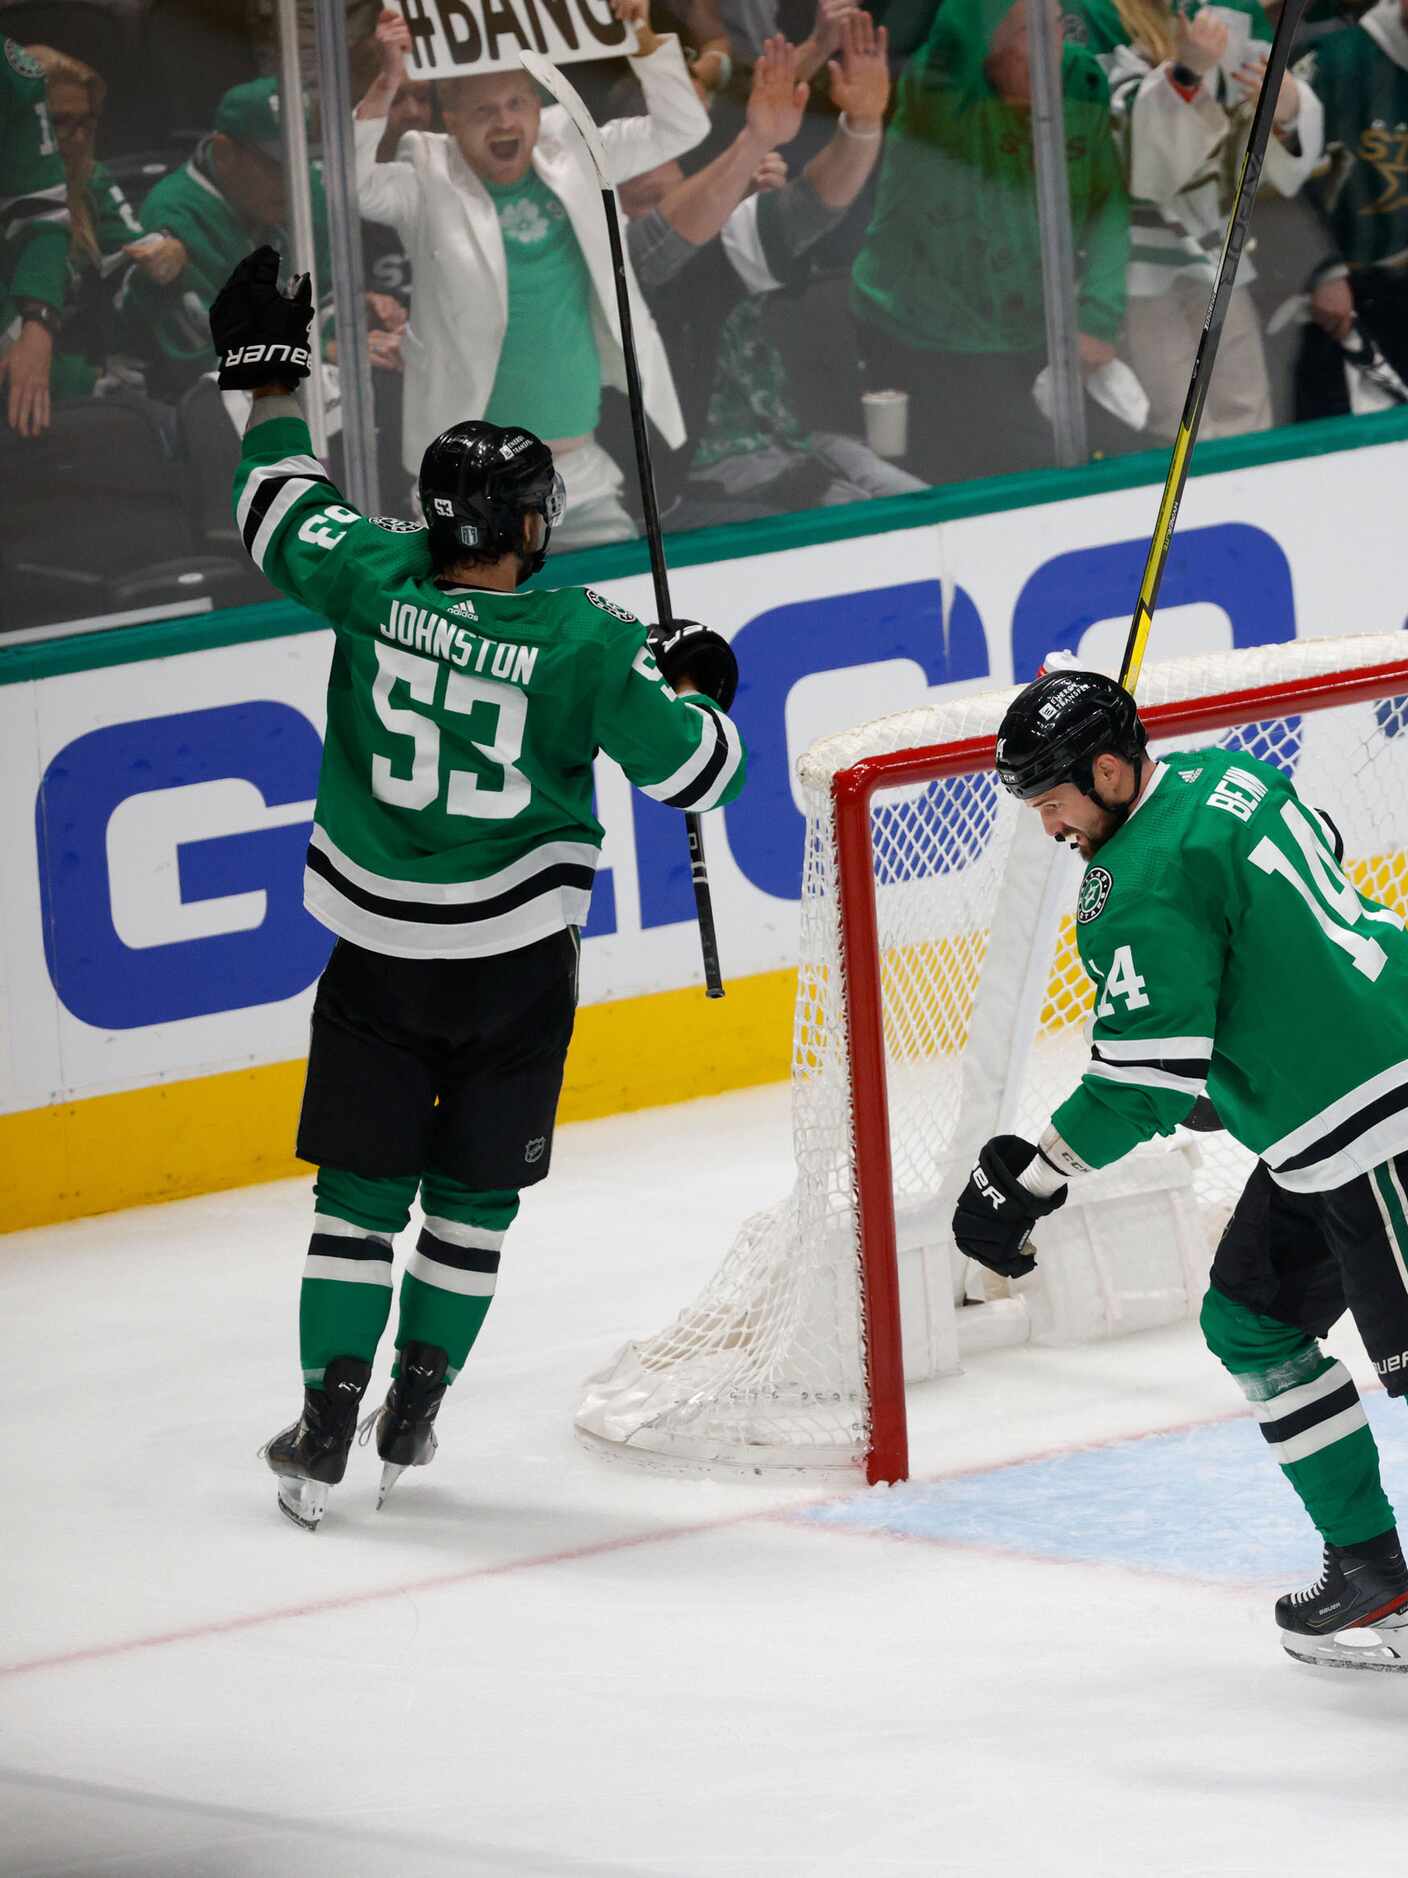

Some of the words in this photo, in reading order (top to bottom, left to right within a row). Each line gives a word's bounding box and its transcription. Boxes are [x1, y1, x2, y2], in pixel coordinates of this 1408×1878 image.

[434, 498, 454, 517] 53
[372, 639, 532, 819] 53
[380, 600, 539, 685] JOHNSTON
[36, 521, 1302, 1030] GCO
[1248, 799, 1404, 983] 14
